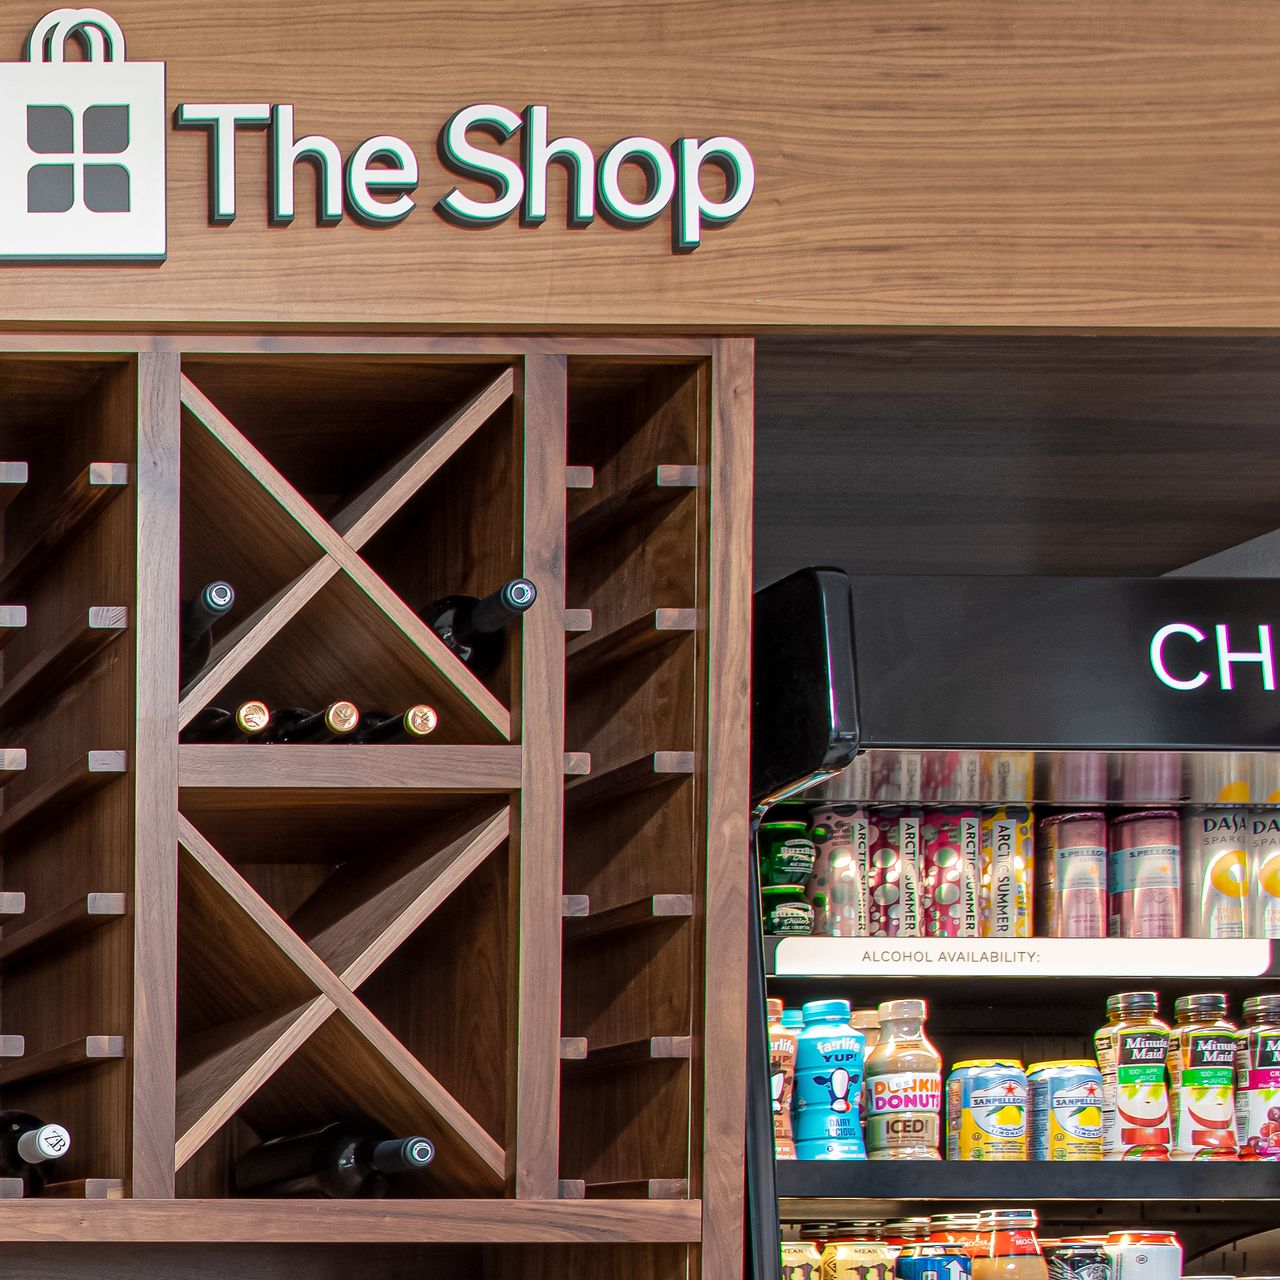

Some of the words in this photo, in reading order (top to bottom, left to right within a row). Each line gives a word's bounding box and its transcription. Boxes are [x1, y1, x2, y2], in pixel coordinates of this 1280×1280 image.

[174, 103, 419, 228] The
[434, 103, 756, 253] Shop
[997, 824, 1010, 871] ARCTIC
[904, 876, 916, 931] SUMMER
[997, 876, 1009, 934] SUMMER
[862, 951, 933, 963] ALCOHOL
[938, 951, 1041, 963] AVAILABILITY:
[1125, 1037, 1169, 1049] Minute
[822, 1053, 857, 1063] YUP!
[1131, 1048, 1164, 1060] Maid
[1202, 1051, 1234, 1062] Maid
[885, 1119, 924, 1134] ICED
